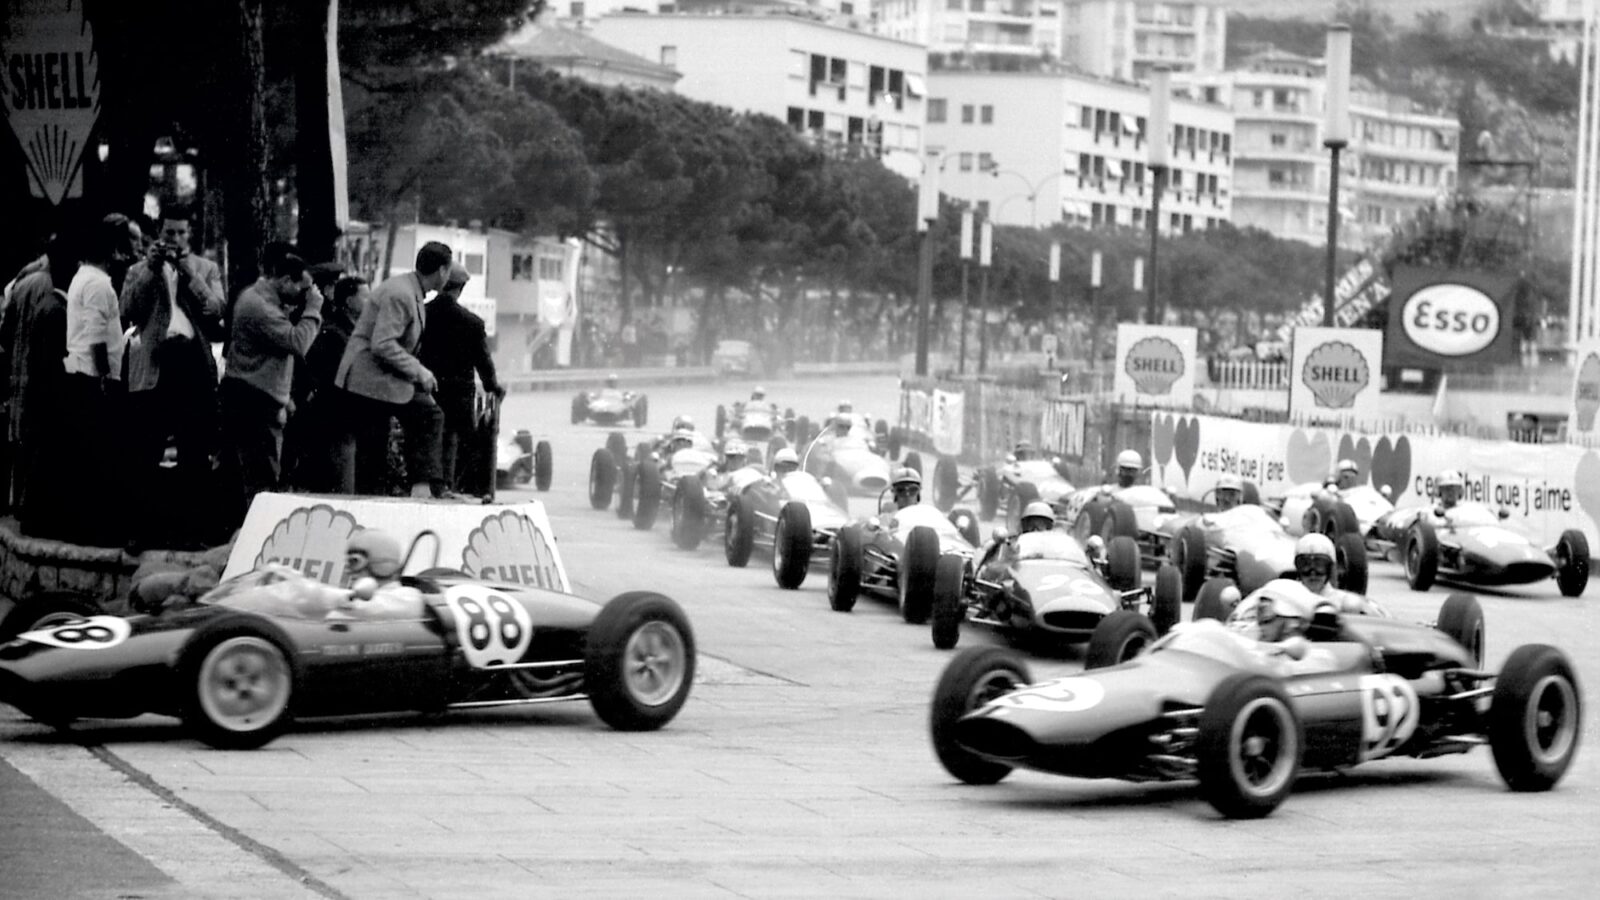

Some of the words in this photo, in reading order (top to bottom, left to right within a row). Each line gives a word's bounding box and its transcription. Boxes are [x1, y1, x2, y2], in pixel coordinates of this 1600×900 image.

[9, 52, 92, 110] SHELL
[1412, 300, 1489, 334] Esso
[1133, 356, 1177, 374] SHELL
[1311, 365, 1361, 383] SHELL
[1457, 471, 1490, 503] hell
[1494, 483, 1521, 510] que
[1534, 479, 1573, 513] aime
[457, 595, 523, 651] 88
